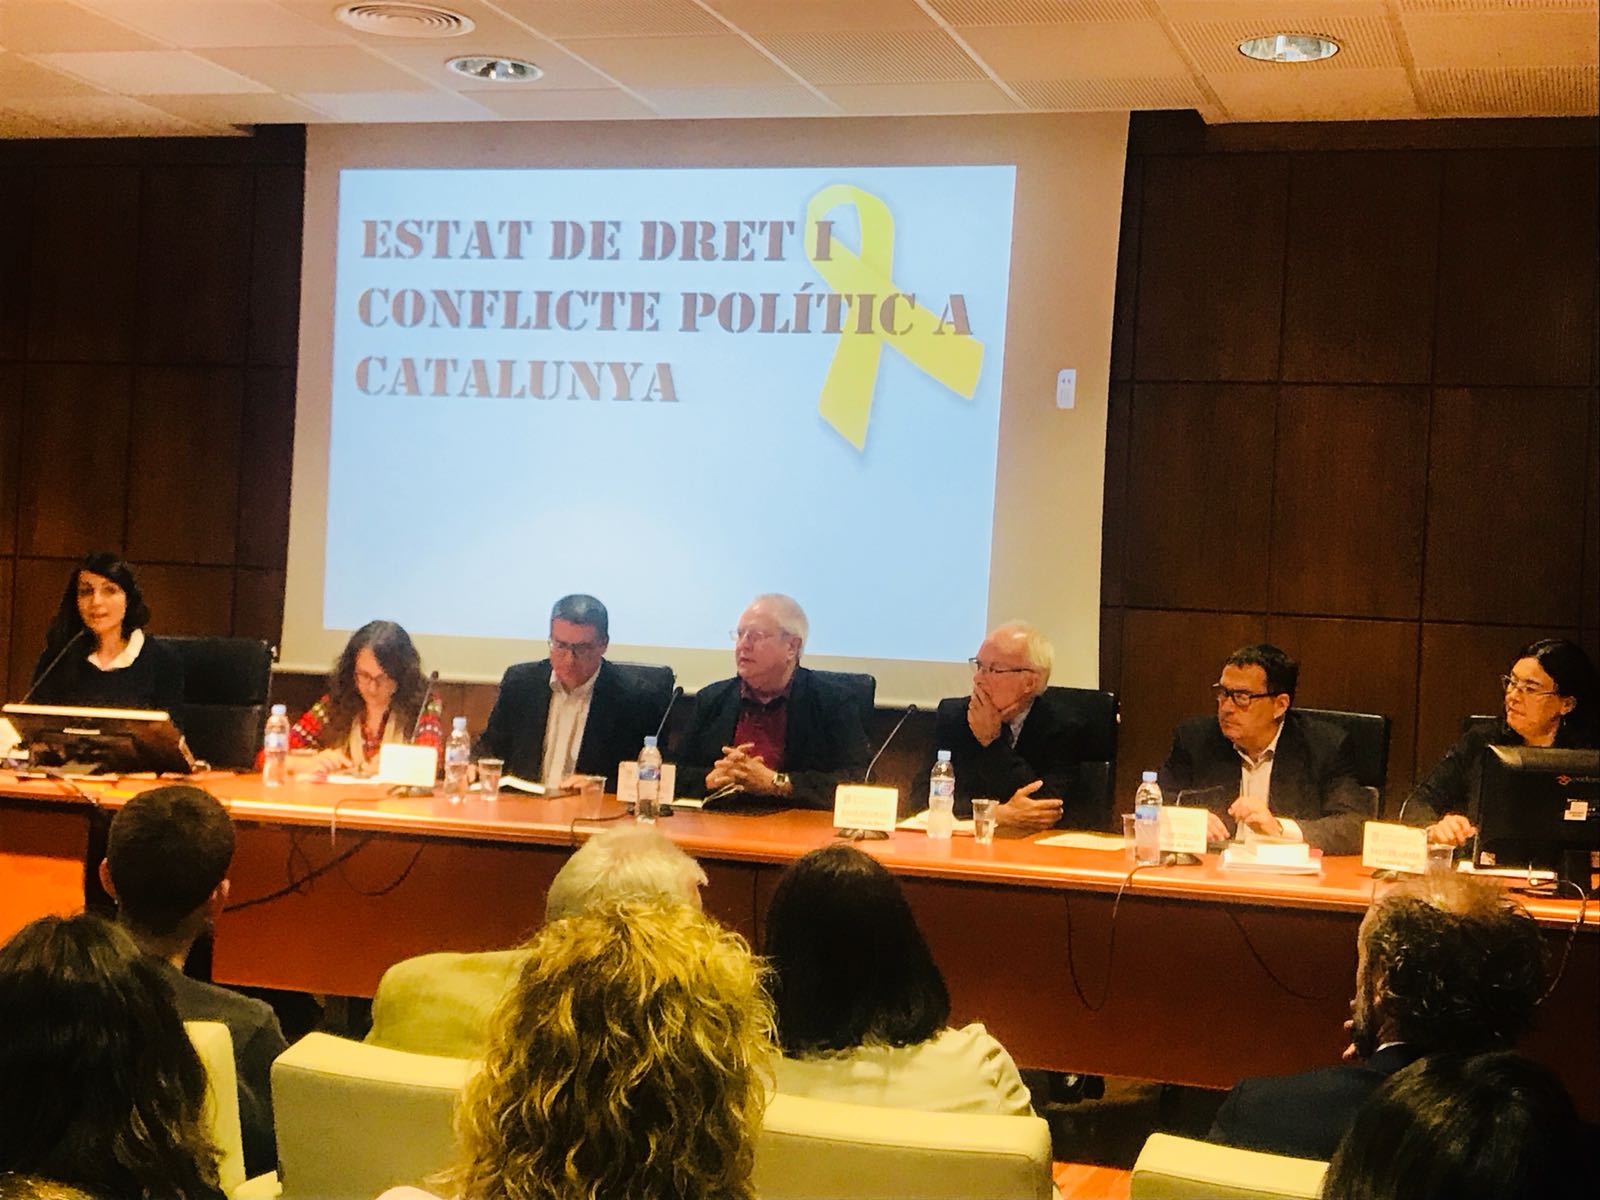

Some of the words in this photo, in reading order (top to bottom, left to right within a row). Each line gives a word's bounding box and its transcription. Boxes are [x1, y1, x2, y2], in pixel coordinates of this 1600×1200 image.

[362, 220, 532, 260] ESTAT
[549, 220, 621, 261] DE
[638, 220, 795, 261] DRET
[813, 220, 836, 261] I
[358, 288, 661, 331] CONFLICTE
[678, 282, 916, 335] POLÍTIC
[932, 294, 973, 335] A
[355, 356, 679, 402] CATALUNYA
